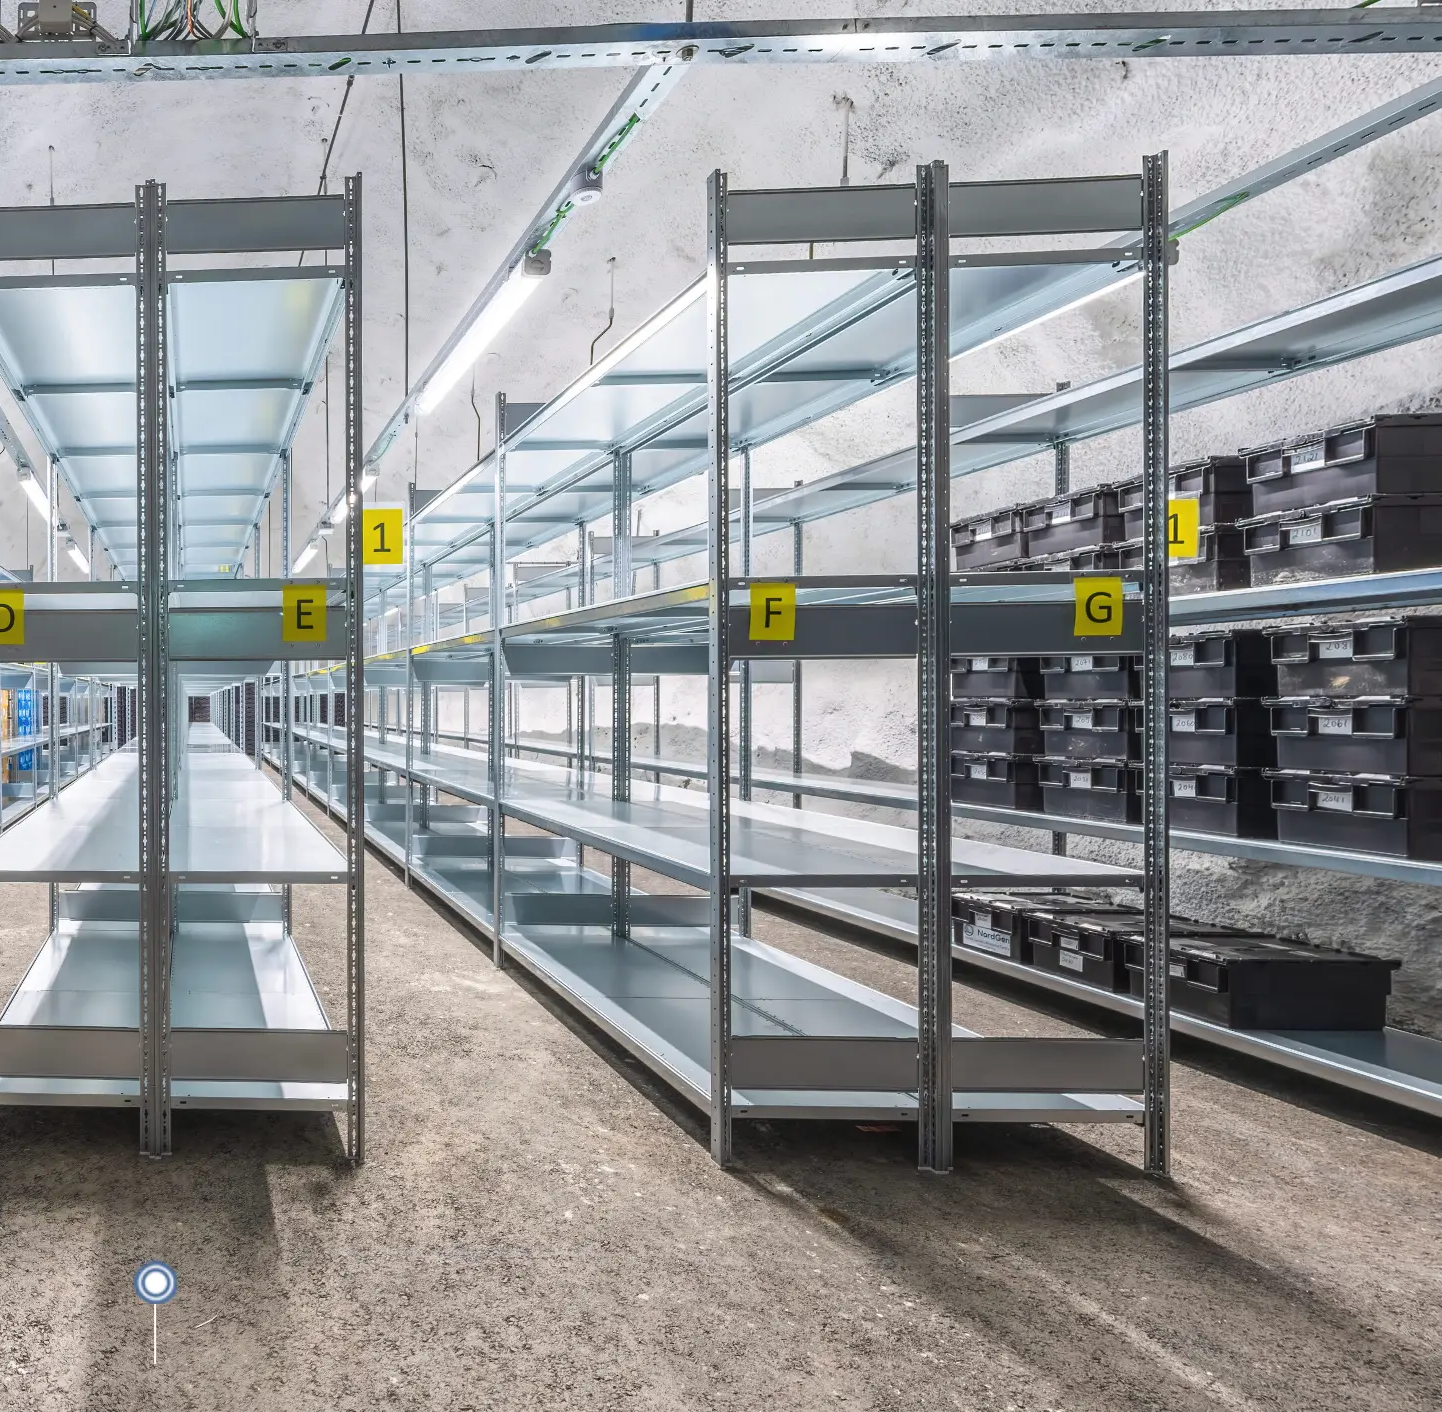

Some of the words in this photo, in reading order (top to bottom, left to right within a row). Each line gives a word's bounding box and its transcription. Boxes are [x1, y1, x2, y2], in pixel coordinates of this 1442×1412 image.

[373, 522, 392, 553] 1
[1167, 513, 1185, 545] 1
[296, 599, 314, 630] E
[764, 597, 783, 629] F
[1085, 591, 1112, 624] G
[977, 929, 1010, 943] NordGen
